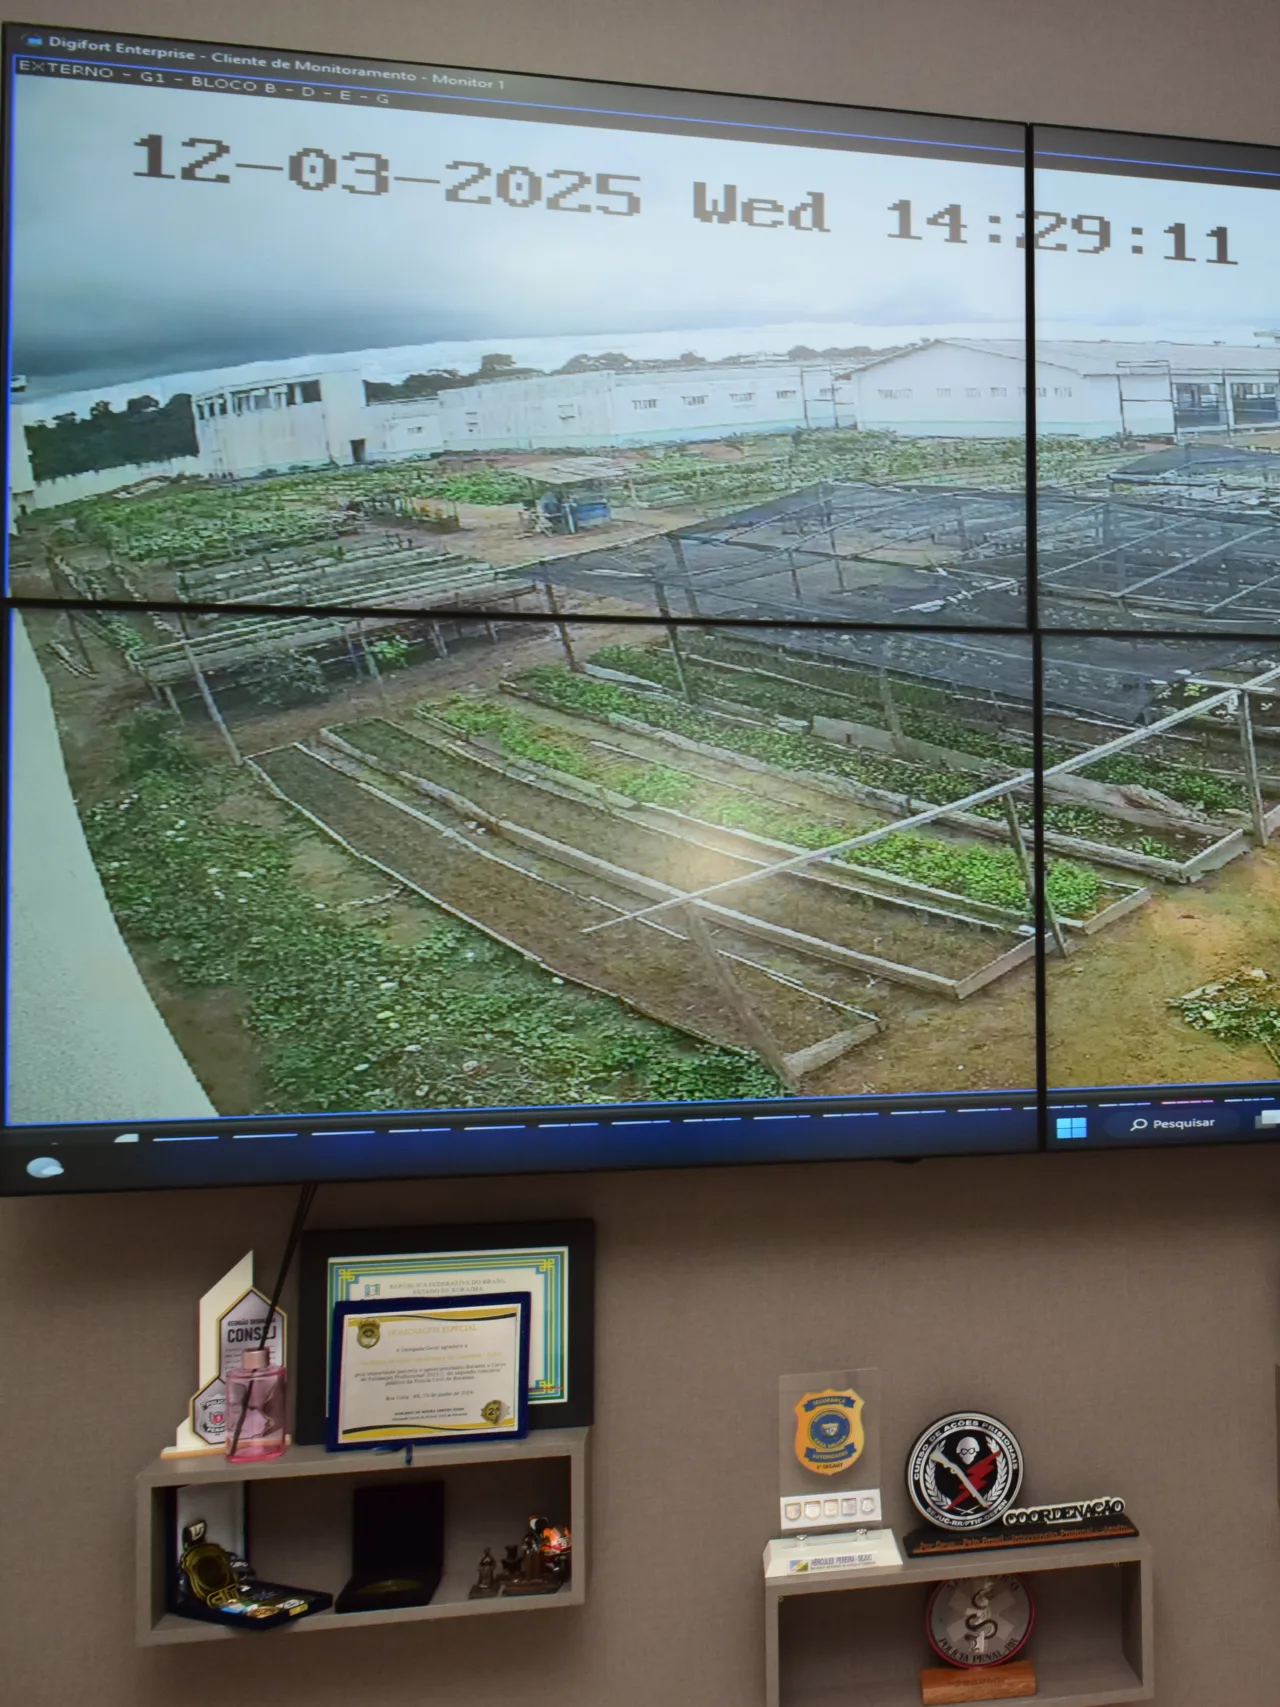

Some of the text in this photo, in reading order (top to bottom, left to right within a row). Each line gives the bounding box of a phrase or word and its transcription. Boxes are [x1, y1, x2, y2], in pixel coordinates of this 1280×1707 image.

[19, 60, 113, 78] EXTERNO
[141, 71, 164, 83] G1
[192, 76, 257, 92] BLOCO
[265, 83, 276, 93] B
[302, 86, 315, 97] D
[340, 90, 351, 100] E
[377, 94, 389, 104] G
[50, 36, 110, 52] Digifort
[116, 42, 195, 60] Enterprise
[212, 52, 267, 67] Cliente
[271, 58, 291, 70] de
[295, 60, 416, 82] Monitoramento
[432, 73, 493, 89] Monitor
[499, 80, 504, 90] 1
[133, 134, 1238, 265] 12-03-2025 Wed 14:29:11
[1153, 1118, 1215, 1130] Pesquisar
[914, 1420, 1018, 1480] CURSO DE AÇÕES PRISIONAIS
[1004, 1497, 1125, 1526] COORDENAÇÃO
